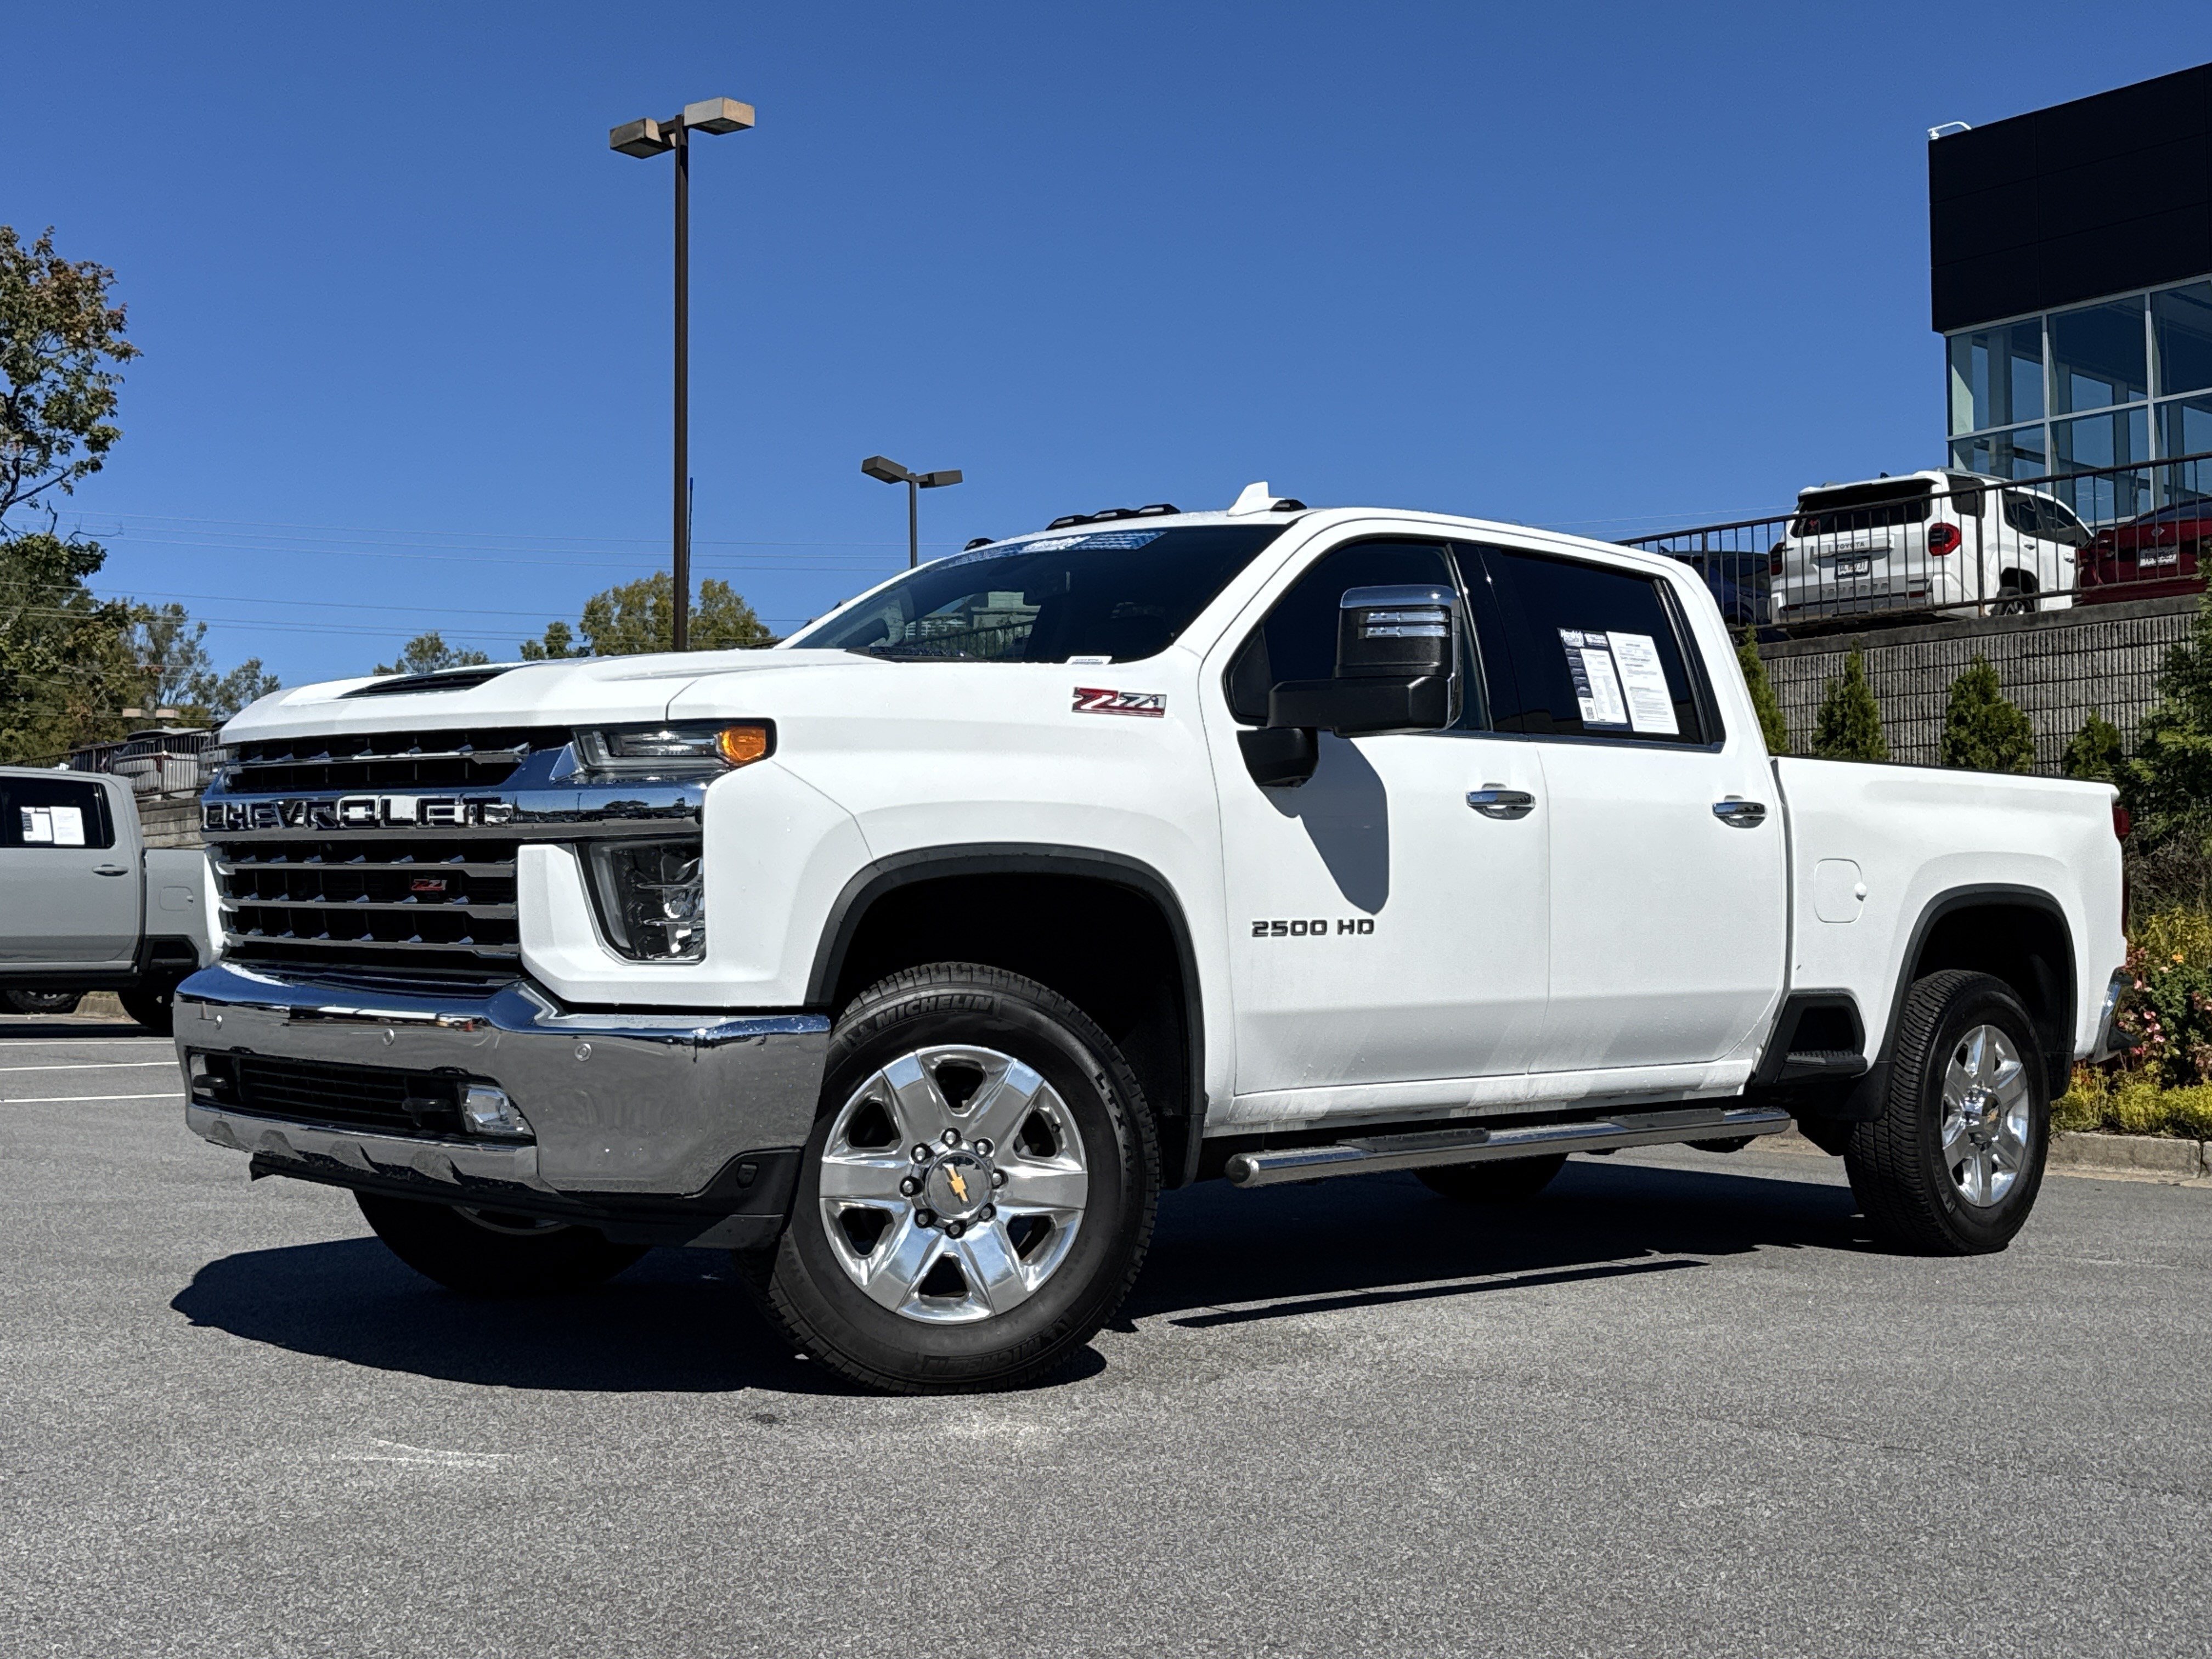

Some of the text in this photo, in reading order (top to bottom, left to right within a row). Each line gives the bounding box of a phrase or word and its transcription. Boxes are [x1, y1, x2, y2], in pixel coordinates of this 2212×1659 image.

[1072, 686, 1167, 718] Z71
[201, 794, 502, 831] CHEVROLET
[411, 879, 448, 891] Z71
[1251, 918, 1375, 938] 2500 HD
[875, 994, 994, 1029] MICHELIN
[1095, 1073, 1125, 1131] LTX
